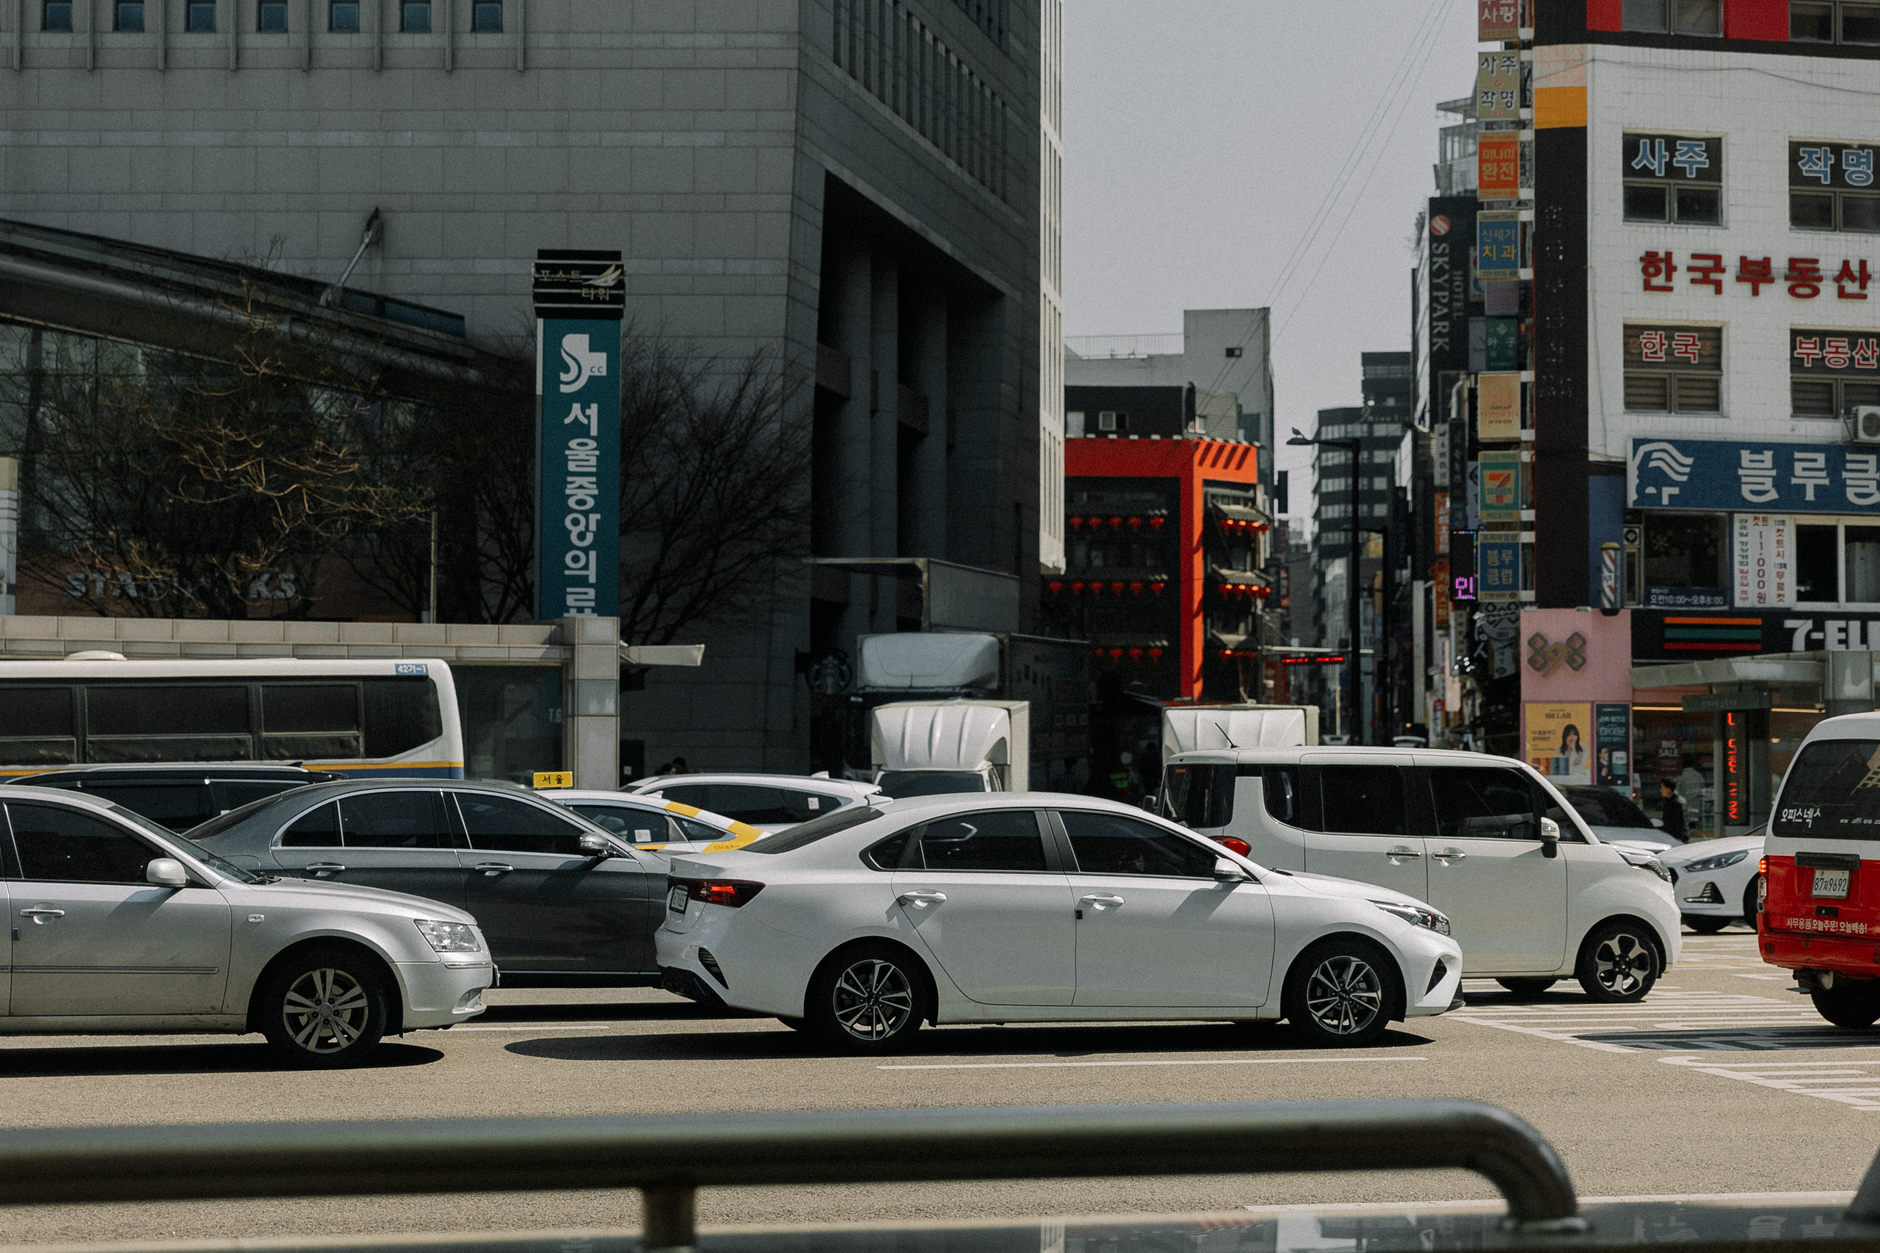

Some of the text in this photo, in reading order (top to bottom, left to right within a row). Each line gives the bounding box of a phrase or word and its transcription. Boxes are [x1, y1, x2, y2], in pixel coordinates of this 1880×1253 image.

[1481, 6, 1516, 23] 사랑
[1481, 55, 1518, 76] 사주
[1481, 90, 1517, 111] 작명
[1482, 162, 1515, 181] 환전
[1631, 138, 1710, 178] 사주
[1797, 146, 1874, 187] 작명
[1482, 244, 1517, 261] 치과
[538, 269, 583, 283] 포스트
[1639, 250, 1872, 300] 한국부동산
[581, 287, 610, 301] 타워
[1431, 242, 1450, 352] SKYPARK
[1452, 270, 1464, 320] HOTEL
[1639, 331, 1701, 364] 한국
[1794, 336, 1879, 369] 부동산
[563, 402, 601, 617] 서울중앙의료
[66, 571, 297, 600] STAKS
[542, 774, 564, 784] 서울
